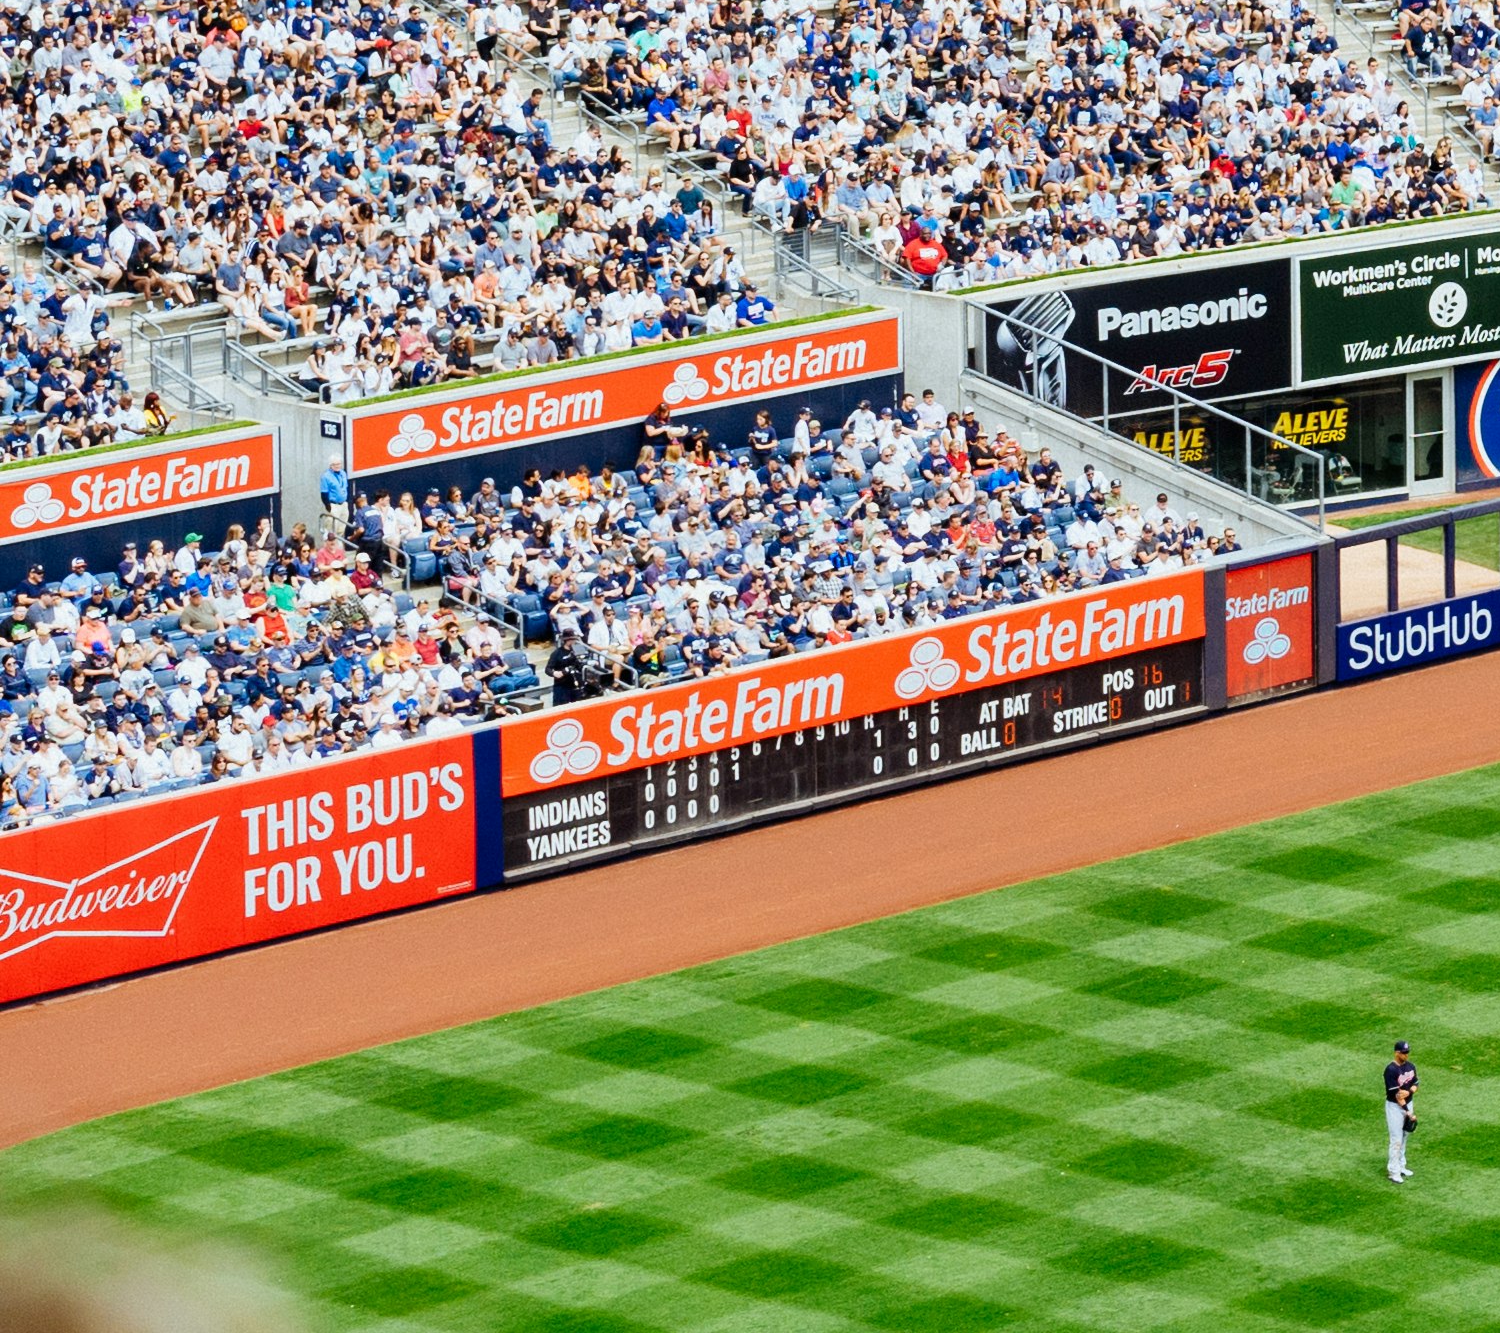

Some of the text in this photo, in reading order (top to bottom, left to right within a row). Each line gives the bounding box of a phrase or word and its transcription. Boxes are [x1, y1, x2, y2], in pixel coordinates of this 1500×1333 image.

[1313, 260, 1407, 288] Workmen's
[1411, 252, 1460, 274] Circle
[1097, 288, 1267, 341] Panasonic
[1348, 609, 1492, 671] StubHub
[241, 763, 465, 856] THIS BUD'S
[529, 791, 606, 831] INDIANS
[527, 821, 611, 862] YANKEES
[244, 833, 425, 918] FOR YOU.
